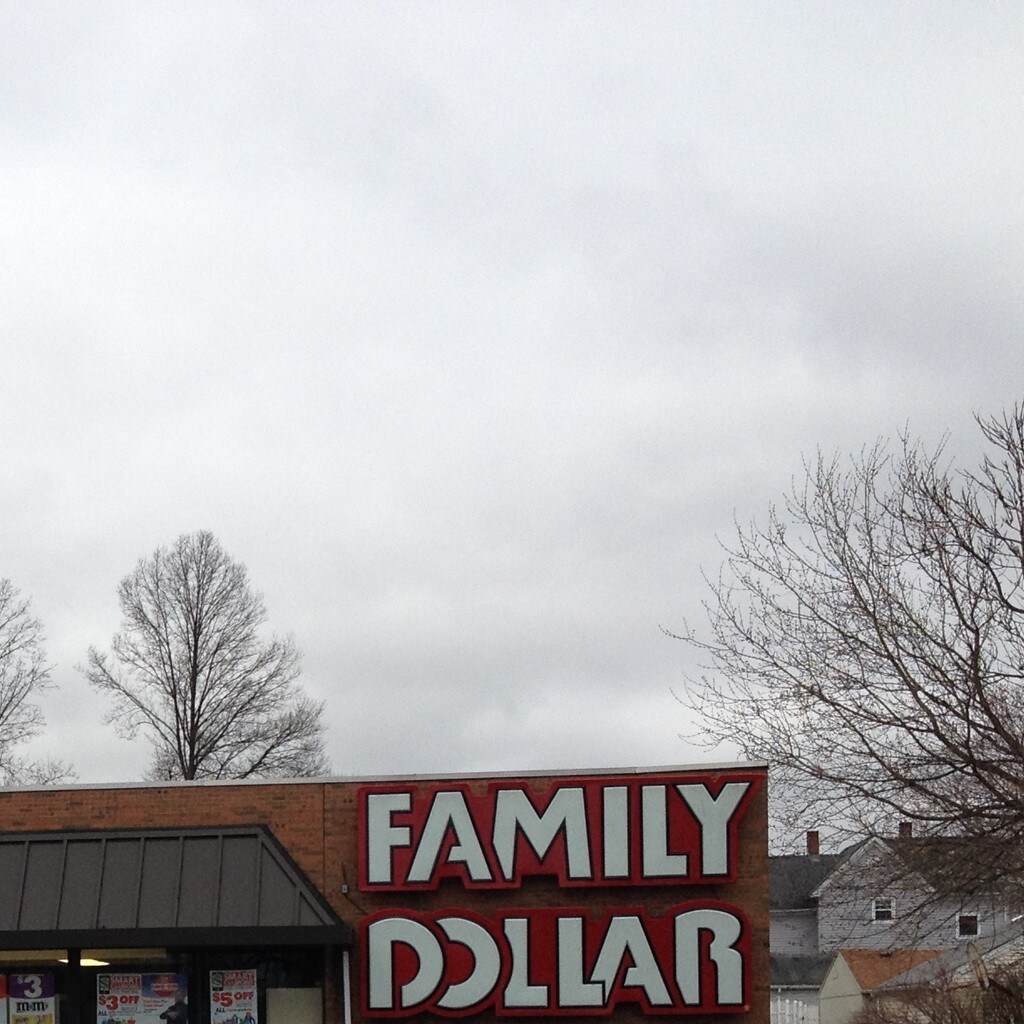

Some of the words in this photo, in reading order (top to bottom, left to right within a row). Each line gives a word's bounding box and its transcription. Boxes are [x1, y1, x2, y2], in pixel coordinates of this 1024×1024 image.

[367, 782, 751, 883] FAMILY
[367, 909, 744, 1009] DOLLAR
[17, 975, 43, 998] $3
[98, 995, 119, 1011] $3
[119, 995, 140, 1004] OFF
[212, 991, 233, 1007] $5
[234, 991, 254, 1000] OFF
